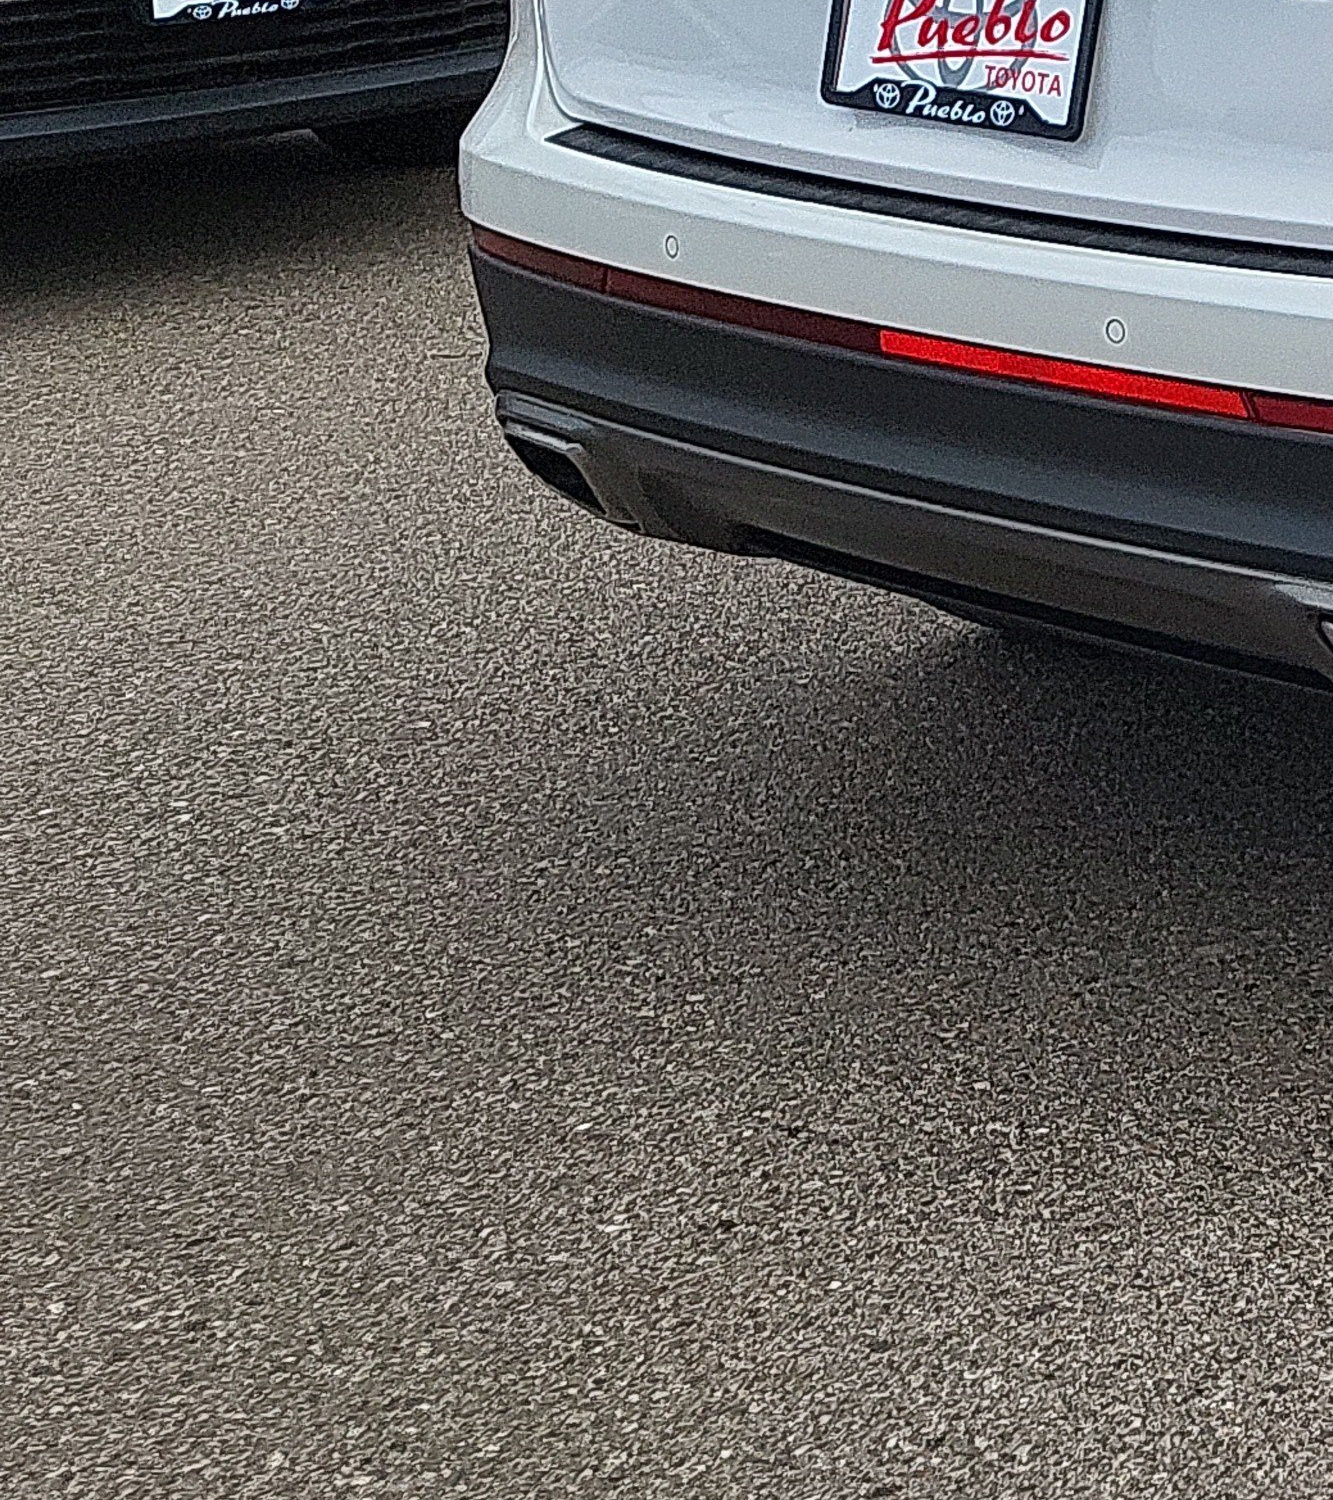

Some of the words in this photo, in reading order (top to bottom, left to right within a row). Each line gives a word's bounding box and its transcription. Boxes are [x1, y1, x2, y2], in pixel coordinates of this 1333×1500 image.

[211, 0, 279, 20] Pueblo
[984, 64, 1062, 97] TOYOTA
[901, 79, 986, 124] Pueblo
